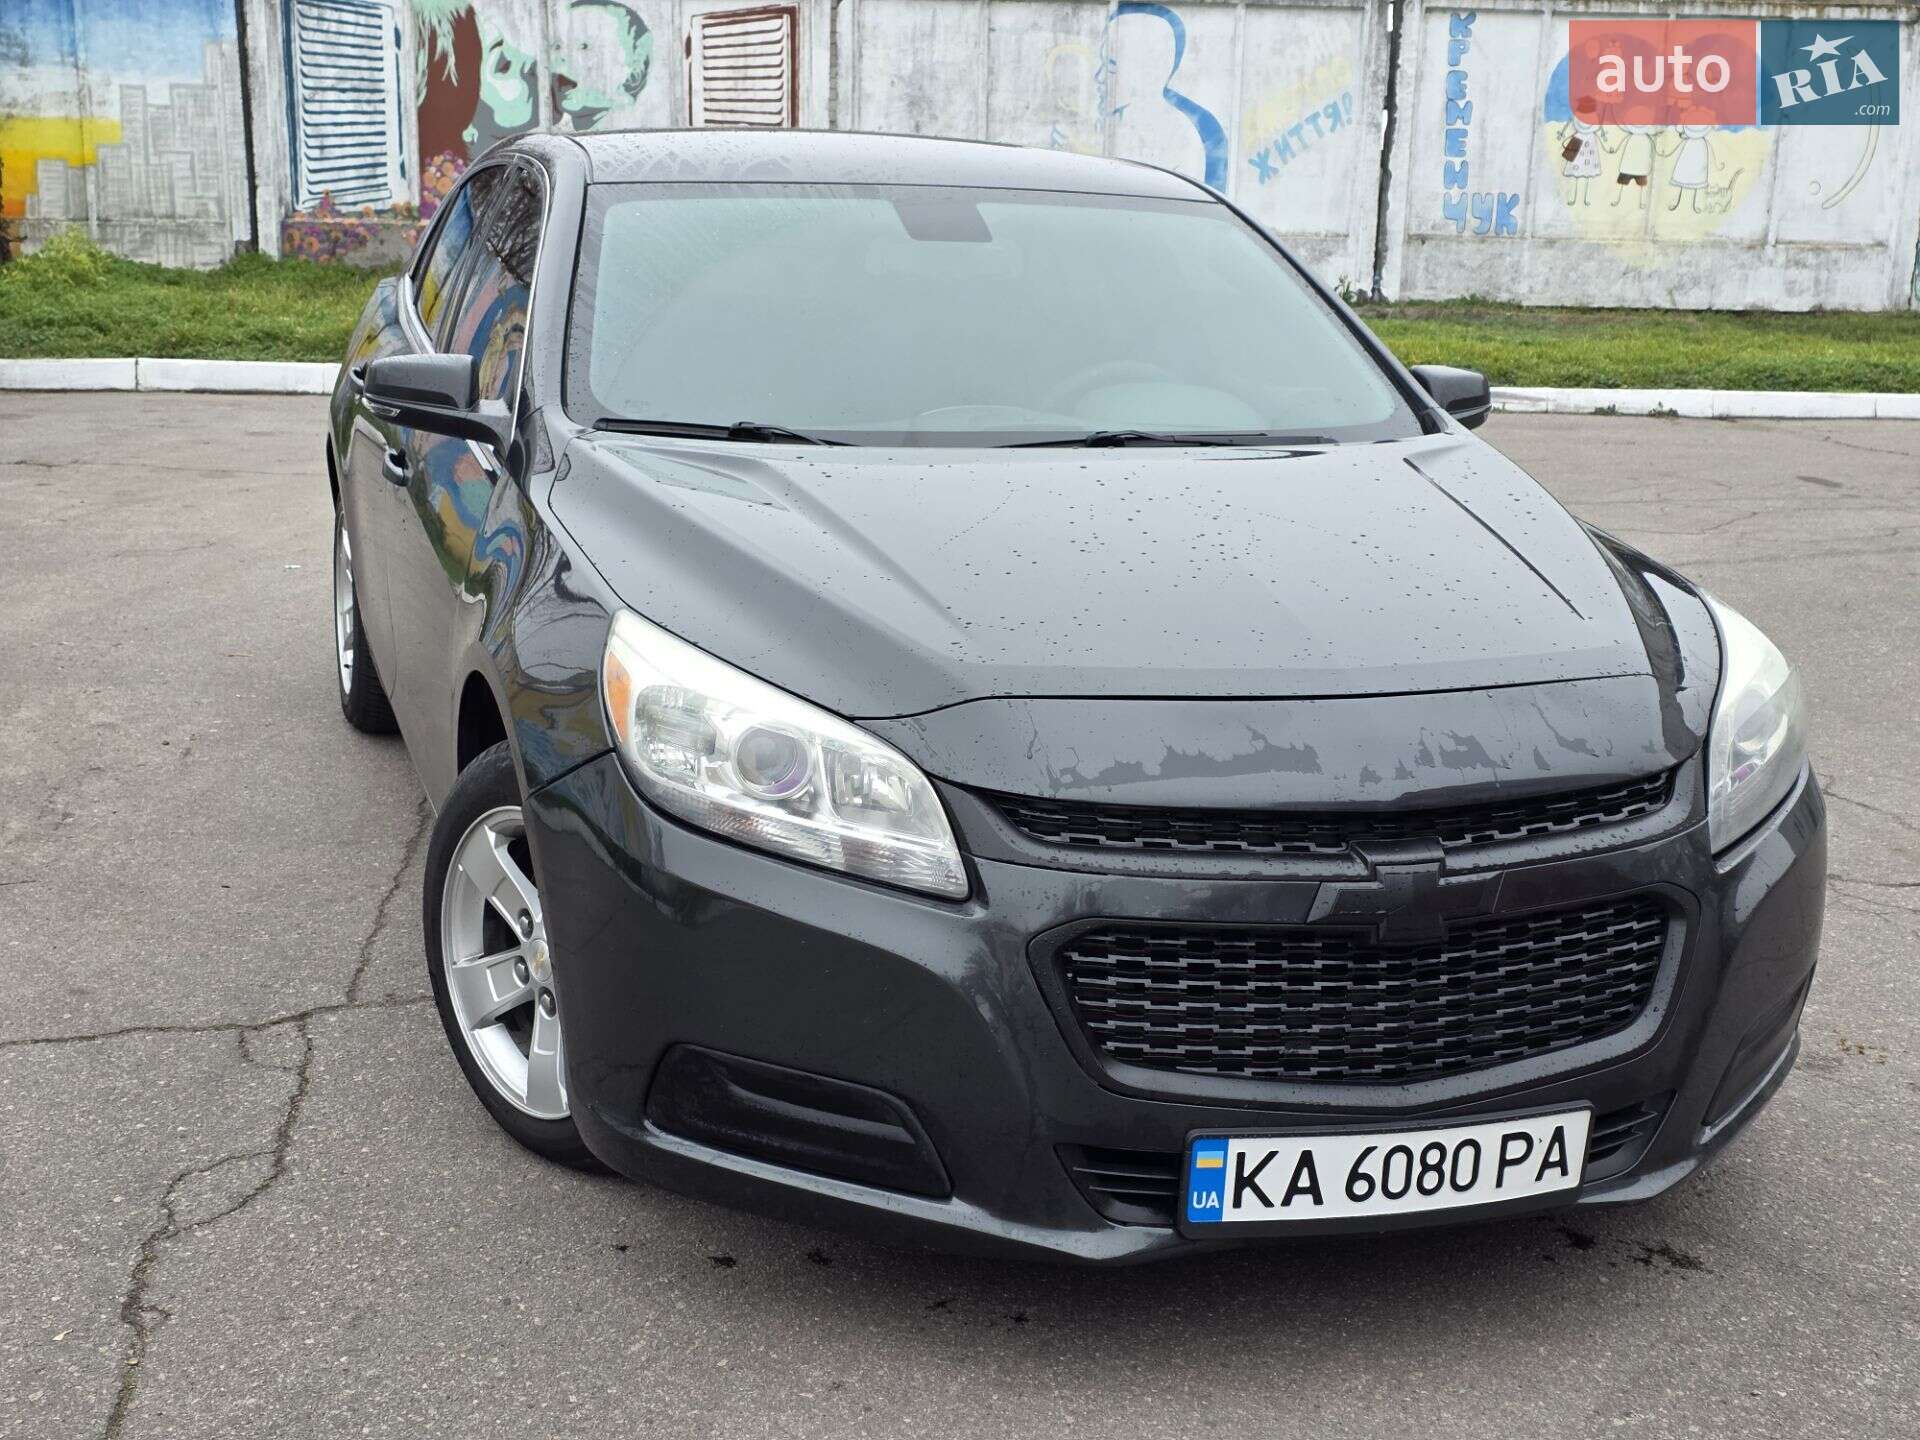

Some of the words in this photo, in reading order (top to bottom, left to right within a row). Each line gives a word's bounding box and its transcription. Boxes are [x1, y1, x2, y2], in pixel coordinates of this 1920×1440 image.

[1248, 91, 1353, 185] ЖИТТЯ!
[1192, 1190, 1220, 1209] UA
[1231, 1149, 1325, 1209] KA
[1345, 1138, 1482, 1203] 6080
[1495, 1125, 1569, 1188] PA
